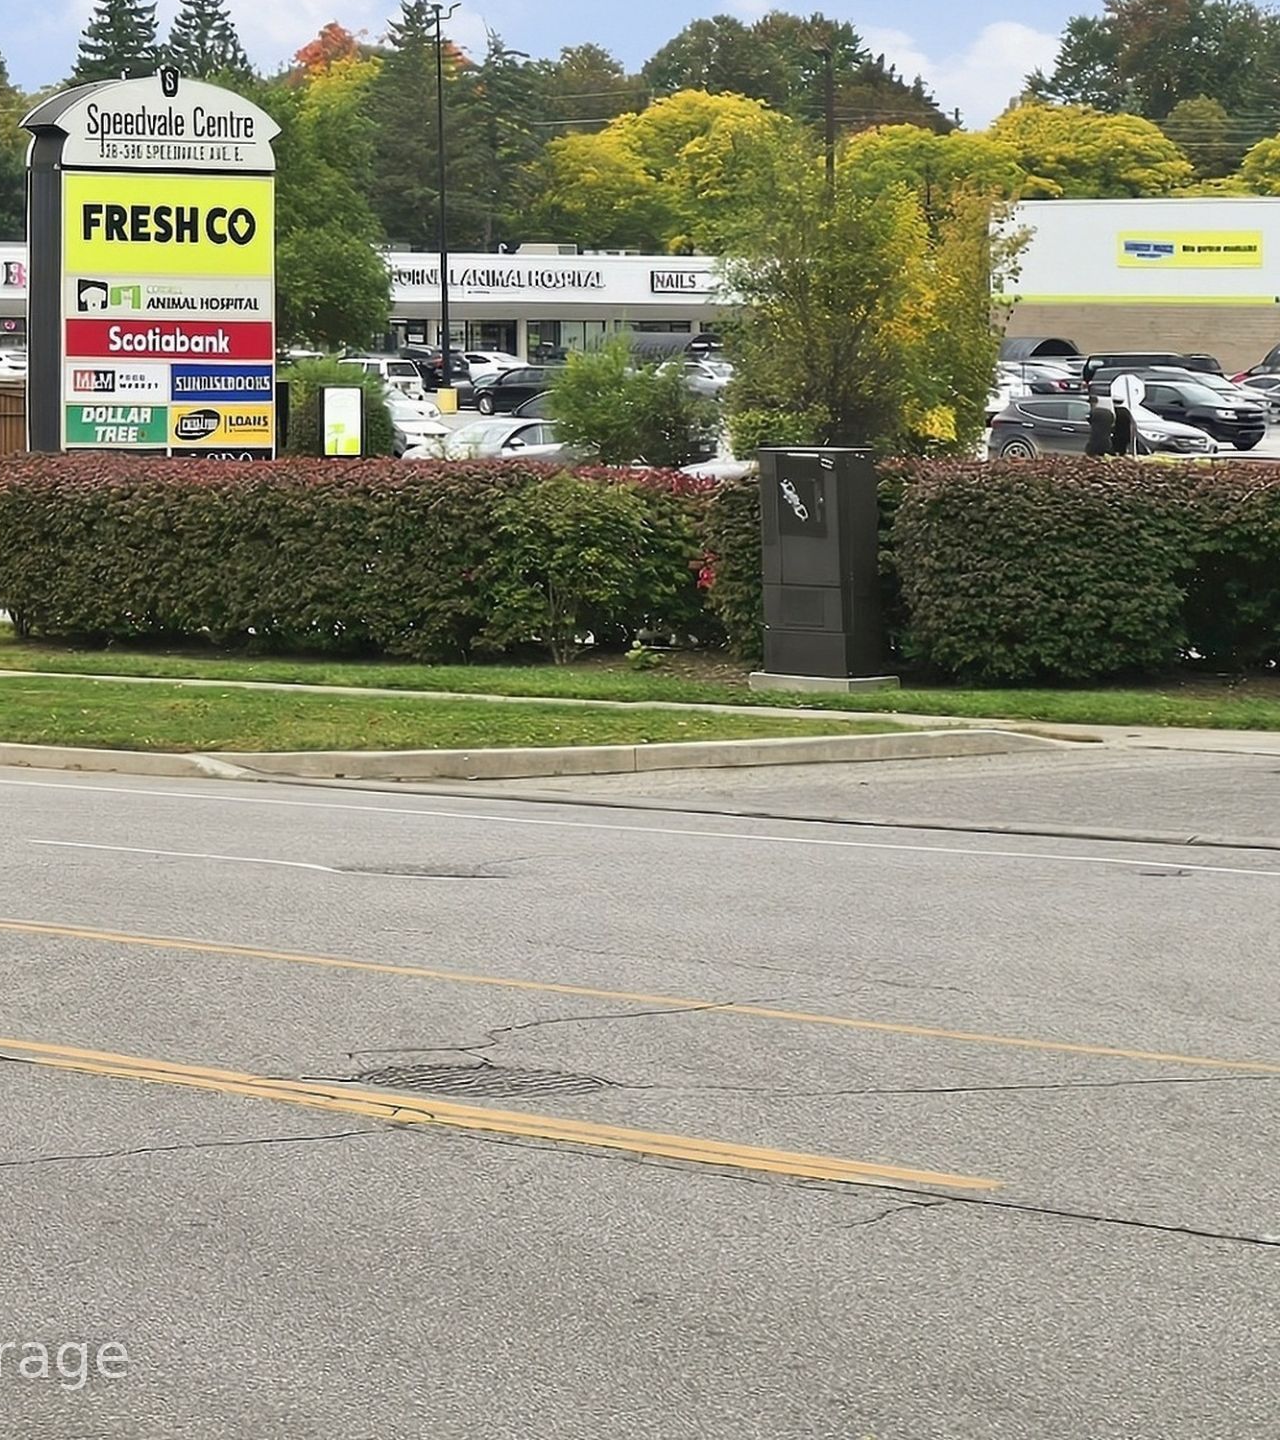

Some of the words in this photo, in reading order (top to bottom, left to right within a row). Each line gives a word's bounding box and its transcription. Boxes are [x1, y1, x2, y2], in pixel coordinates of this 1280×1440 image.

[87, 103, 185, 143] Speedvale
[193, 106, 255, 138] Centre
[82, 204, 199, 243] FRESH
[654, 272, 697, 289] NAILS
[146, 297, 198, 310] ANIMAL
[199, 297, 260, 311] HOSPITAL
[108, 325, 230, 354] Scotiabank
[81, 406, 153, 424] DOLLAR
[229, 415, 269, 427] LOANS
[94, 426, 139, 443] TREE
